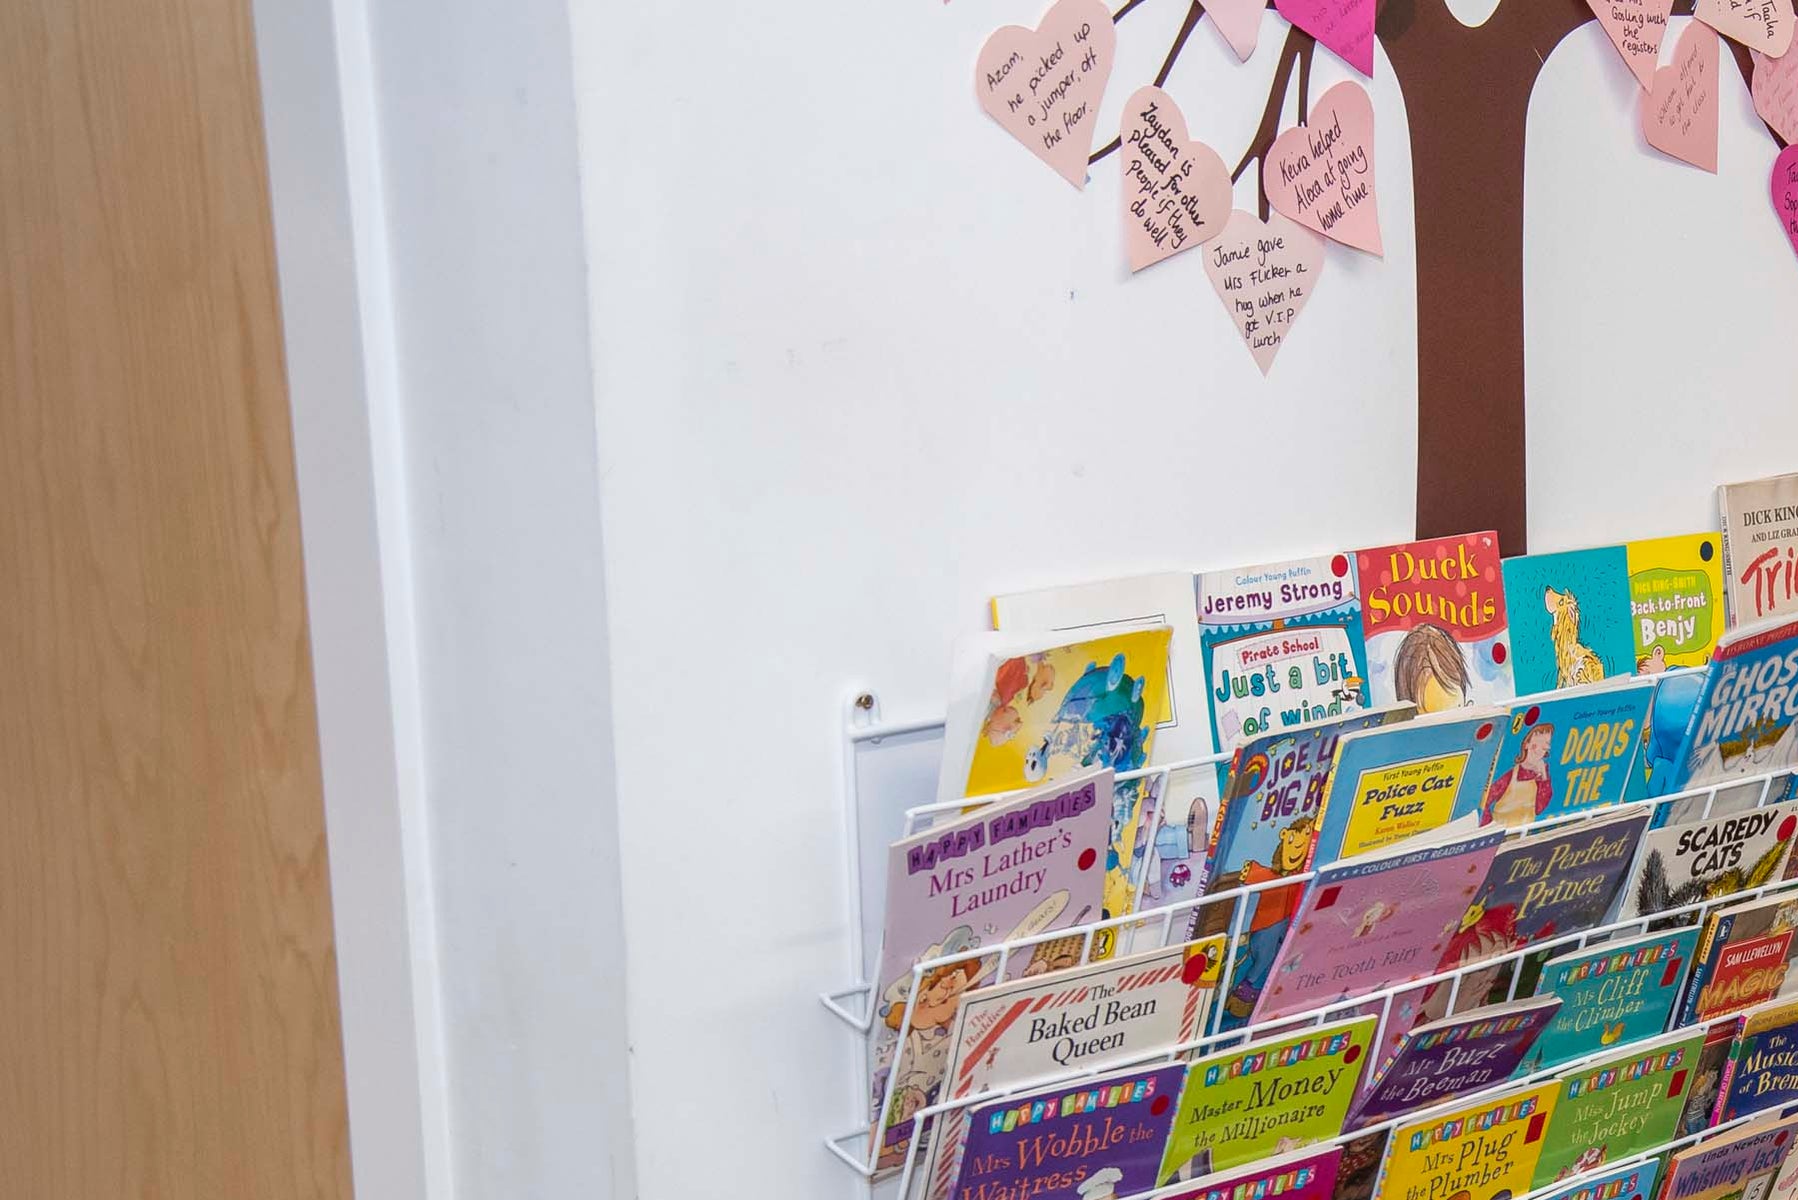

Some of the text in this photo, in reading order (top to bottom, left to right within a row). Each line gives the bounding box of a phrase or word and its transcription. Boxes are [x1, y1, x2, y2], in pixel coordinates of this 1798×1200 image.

[1622, 40, 1657, 56] registers
[1623, 26, 1639, 40] the
[1008, 23, 1090, 112] he picked up
[1279, 109, 1341, 186] Keira helped
[1128, 130, 1205, 227] pleased for other
[1295, 142, 1368, 213] Alexa at going
[1126, 160, 1187, 249] people if they
[1214, 237, 1284, 267] Jamie gave
[1236, 287, 1303, 317] hug when he
[1743, 510, 1772, 526] DICK
[1751, 533, 1767, 543] AND
[1768, 531, 1780, 539] LIZ
[1236, 566, 1311, 586] Colour Young Puffin
[1389, 544, 1478, 583] Duck
[1204, 579, 1343, 614] Jeremy Strong
[1368, 584, 1496, 629] Sounds
[1641, 615, 1696, 647] Benjy
[1241, 637, 1319, 664] Pirate School
[1215, 652, 1352, 703] Just a bit
[1243, 694, 1343, 736] of wind
[1560, 719, 1635, 766] DORIS
[1267, 741, 1310, 790] JOE
[1383, 762, 1444, 780] First Young Puffin
[1260, 780, 1301, 822] BIG
[1362, 775, 1455, 805] Police Cat
[1565, 765, 1610, 805] THE
[1379, 799, 1425, 822] Fuzz
[1676, 810, 1777, 855] SCAREDY
[928, 829, 1072, 898] Mrs Lather's
[1361, 845, 1467, 875] COLOUR FIRST READER
[1505, 832, 1628, 885] The Perfect
[1690, 842, 1743, 877] CATS
[951, 868, 1047, 918] Laundry
[1515, 874, 1605, 921] Prince
[1296, 946, 1419, 991] The Tooth Fairy
[1725, 942, 1782, 968] SAM LLEWELLYN
[1090, 985, 1115, 1000] The
[1598, 968, 1649, 1005] Cliff
[1696, 962, 1789, 1014] MAGIC
[1027, 1010, 1101, 1045] Baked
[1104, 999, 1157, 1025] Bean
[1575, 998, 1644, 1032] Climber
[1052, 1031, 1125, 1066] Queen
[1205, 1031, 1351, 1087] HAPPY FAMILIES
[1403, 1043, 1507, 1077] Mr Buzz
[1768, 1034, 1787, 1049] The
[1189, 1067, 1344, 1125] Master Money
[1382, 1069, 1492, 1102] the Beeman
[1605, 1082, 1663, 1120] Jump
[1739, 1080, 1752, 1094] of
[990, 1077, 1157, 1134] HAPPY FAMILIES
[1194, 1103, 1325, 1147] the Millionaire
[1571, 1113, 1649, 1145] the Jockey
[971, 1117, 1154, 1177] Mrs Wobble the
[1421, 1130, 1517, 1174] Mrs Plug
[1702, 1131, 1776, 1164] Linda Newbery
